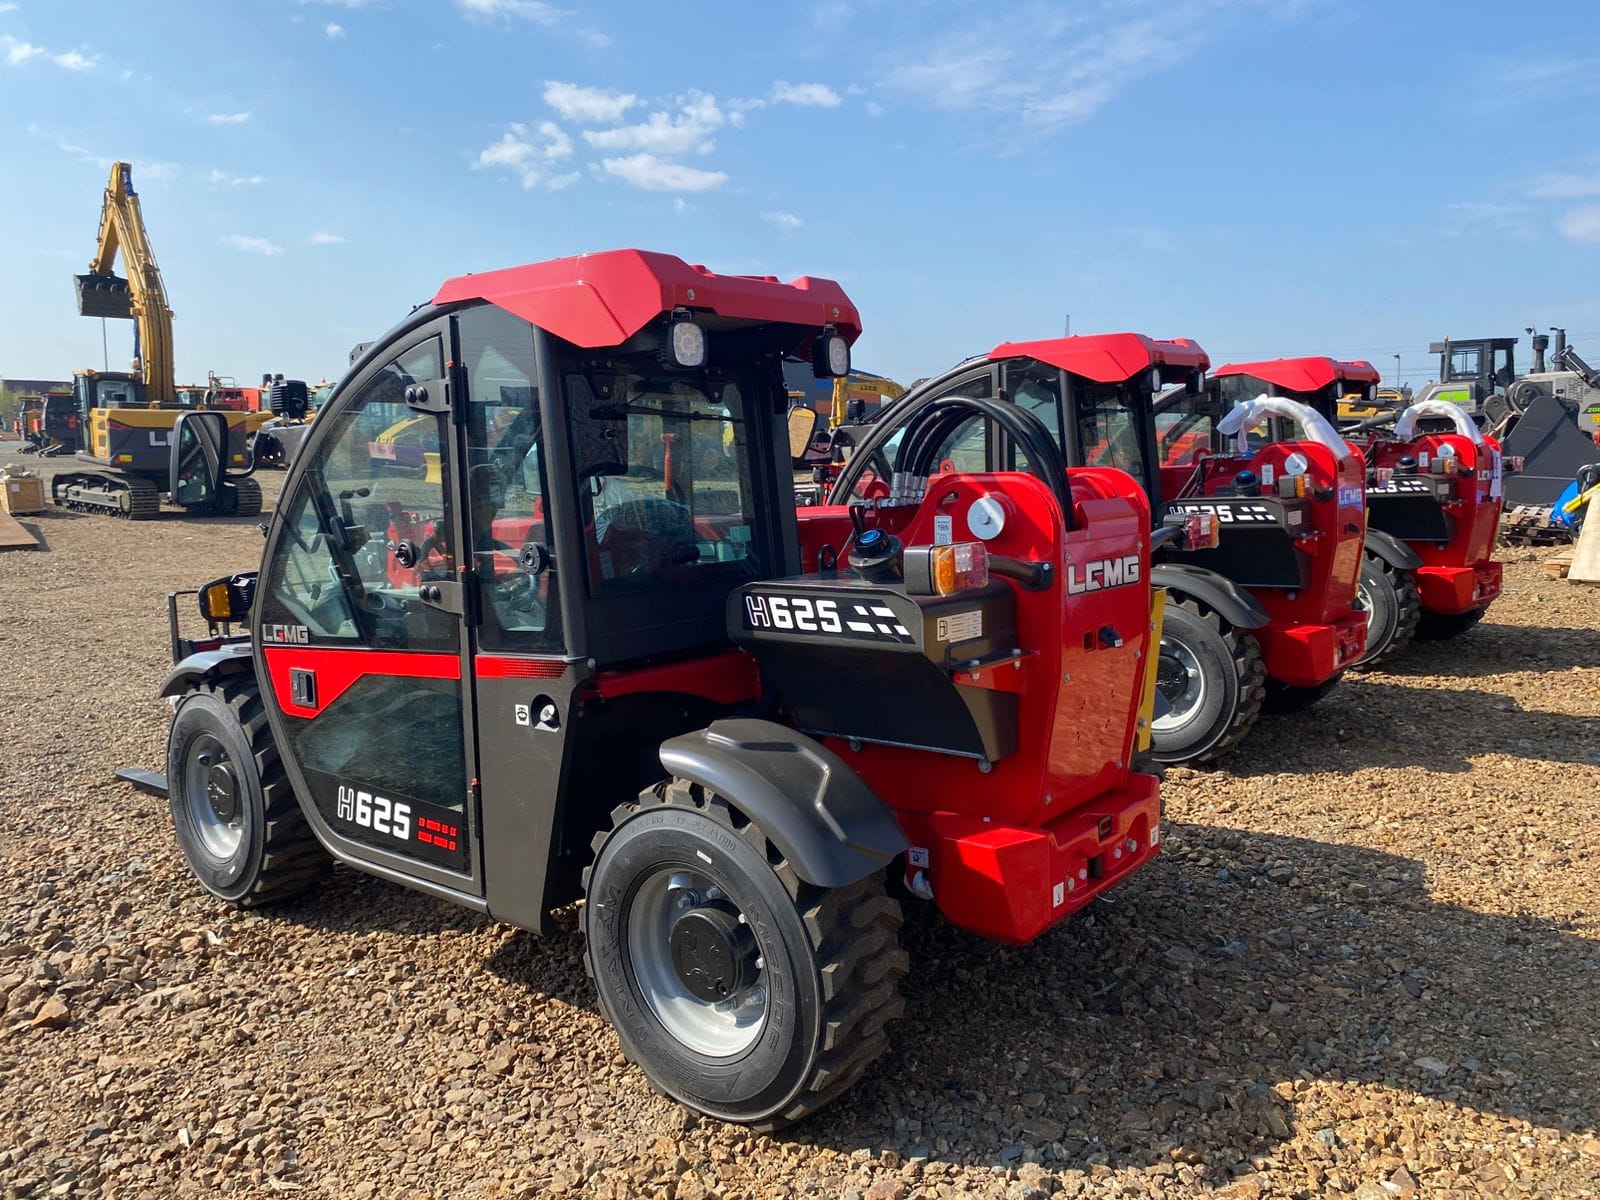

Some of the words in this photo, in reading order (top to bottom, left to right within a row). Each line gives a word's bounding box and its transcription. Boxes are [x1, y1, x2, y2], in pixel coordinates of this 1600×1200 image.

[1067, 555, 1140, 595] LGMG
[262, 623, 309, 644] LGMG
[746, 596, 842, 633] H625
[338, 785, 411, 840] H625
